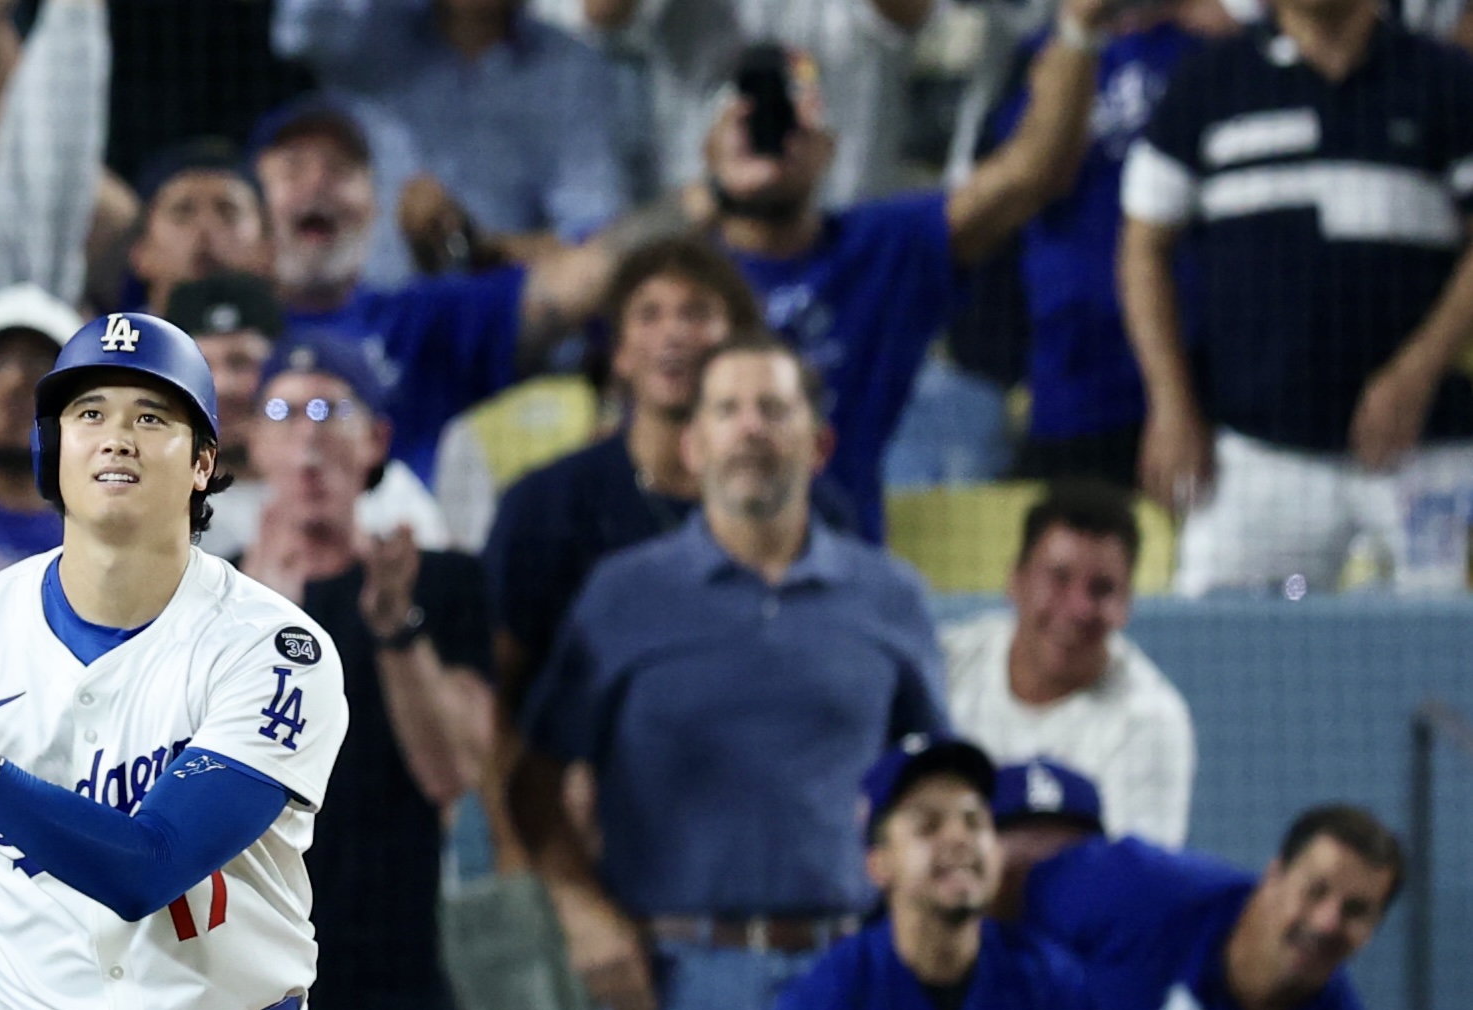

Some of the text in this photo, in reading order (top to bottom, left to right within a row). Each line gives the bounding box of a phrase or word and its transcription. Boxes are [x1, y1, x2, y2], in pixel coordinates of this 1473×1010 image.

[101, 313, 140, 351] LA
[284, 639, 315, 660] 34
[258, 666, 307, 751] LA
